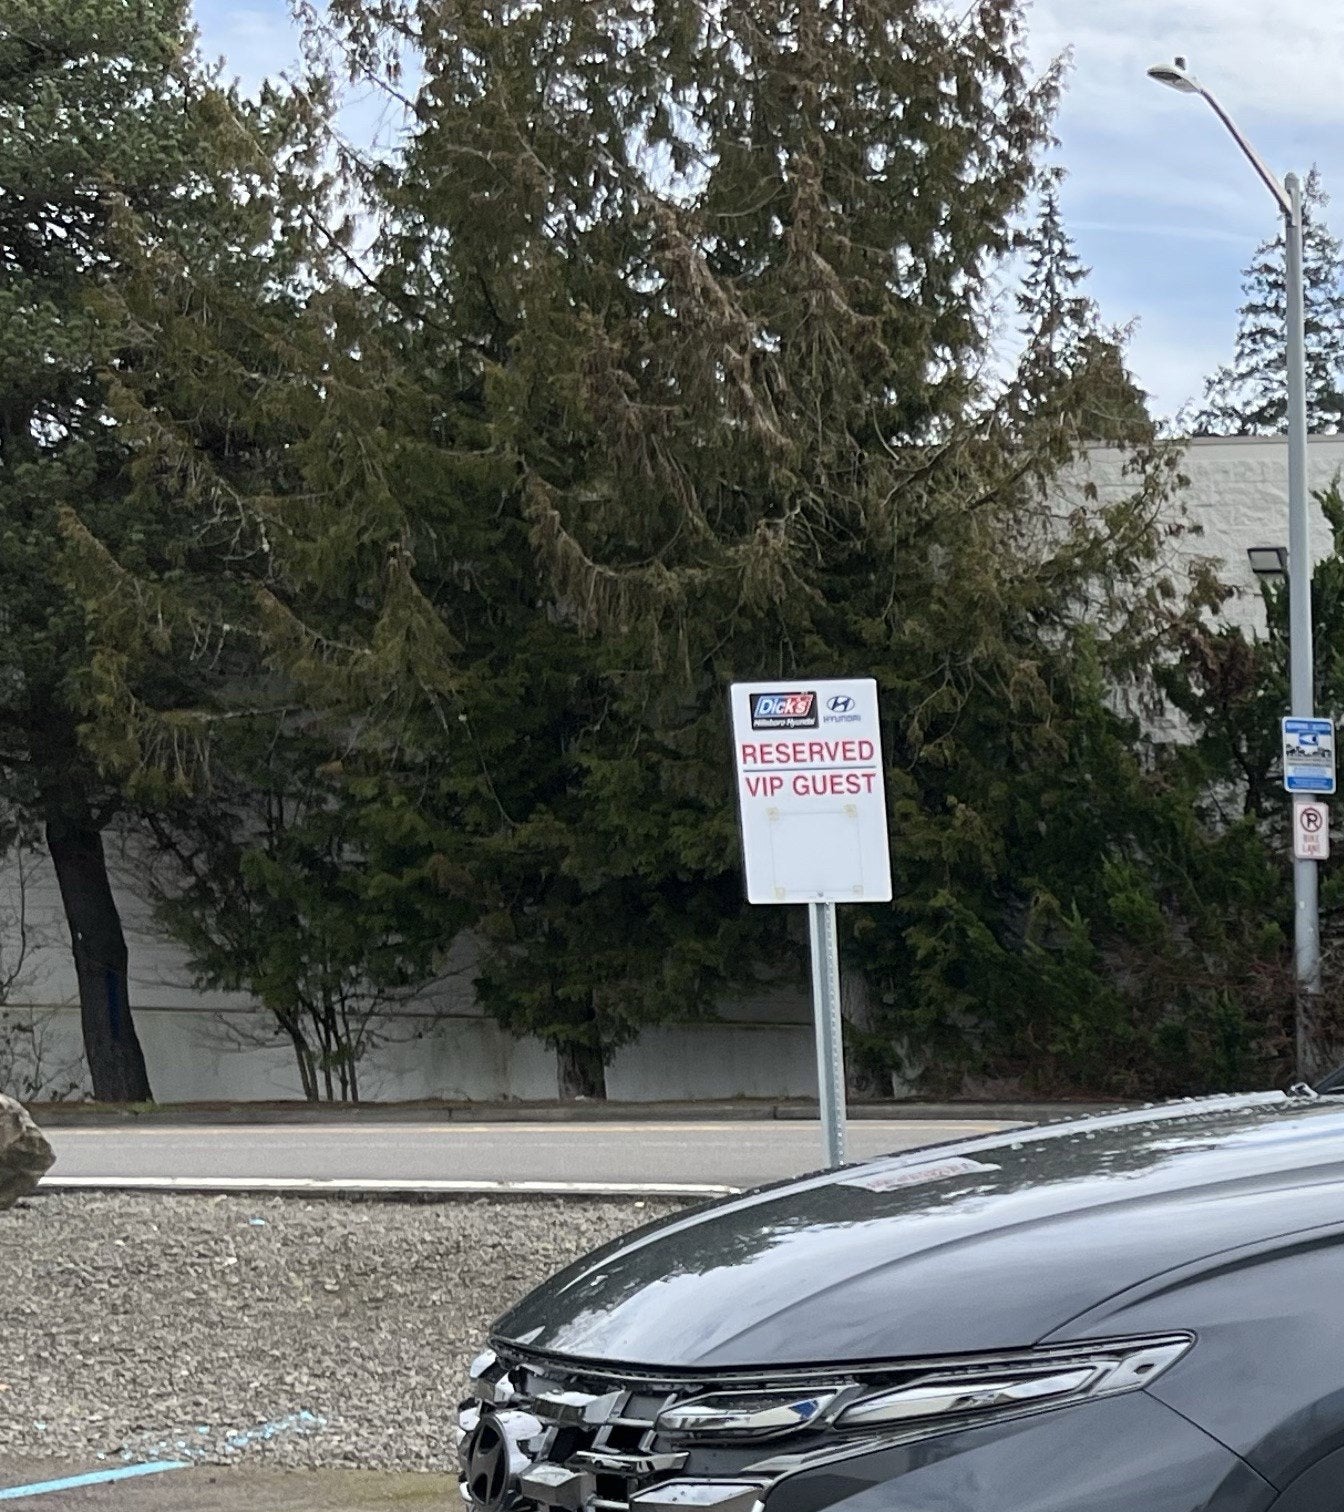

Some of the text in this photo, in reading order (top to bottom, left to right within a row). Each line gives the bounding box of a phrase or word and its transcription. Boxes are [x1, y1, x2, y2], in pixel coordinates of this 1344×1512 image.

[742, 741, 875, 764] RESERVED
[746, 773, 876, 796] VIP GUEST
